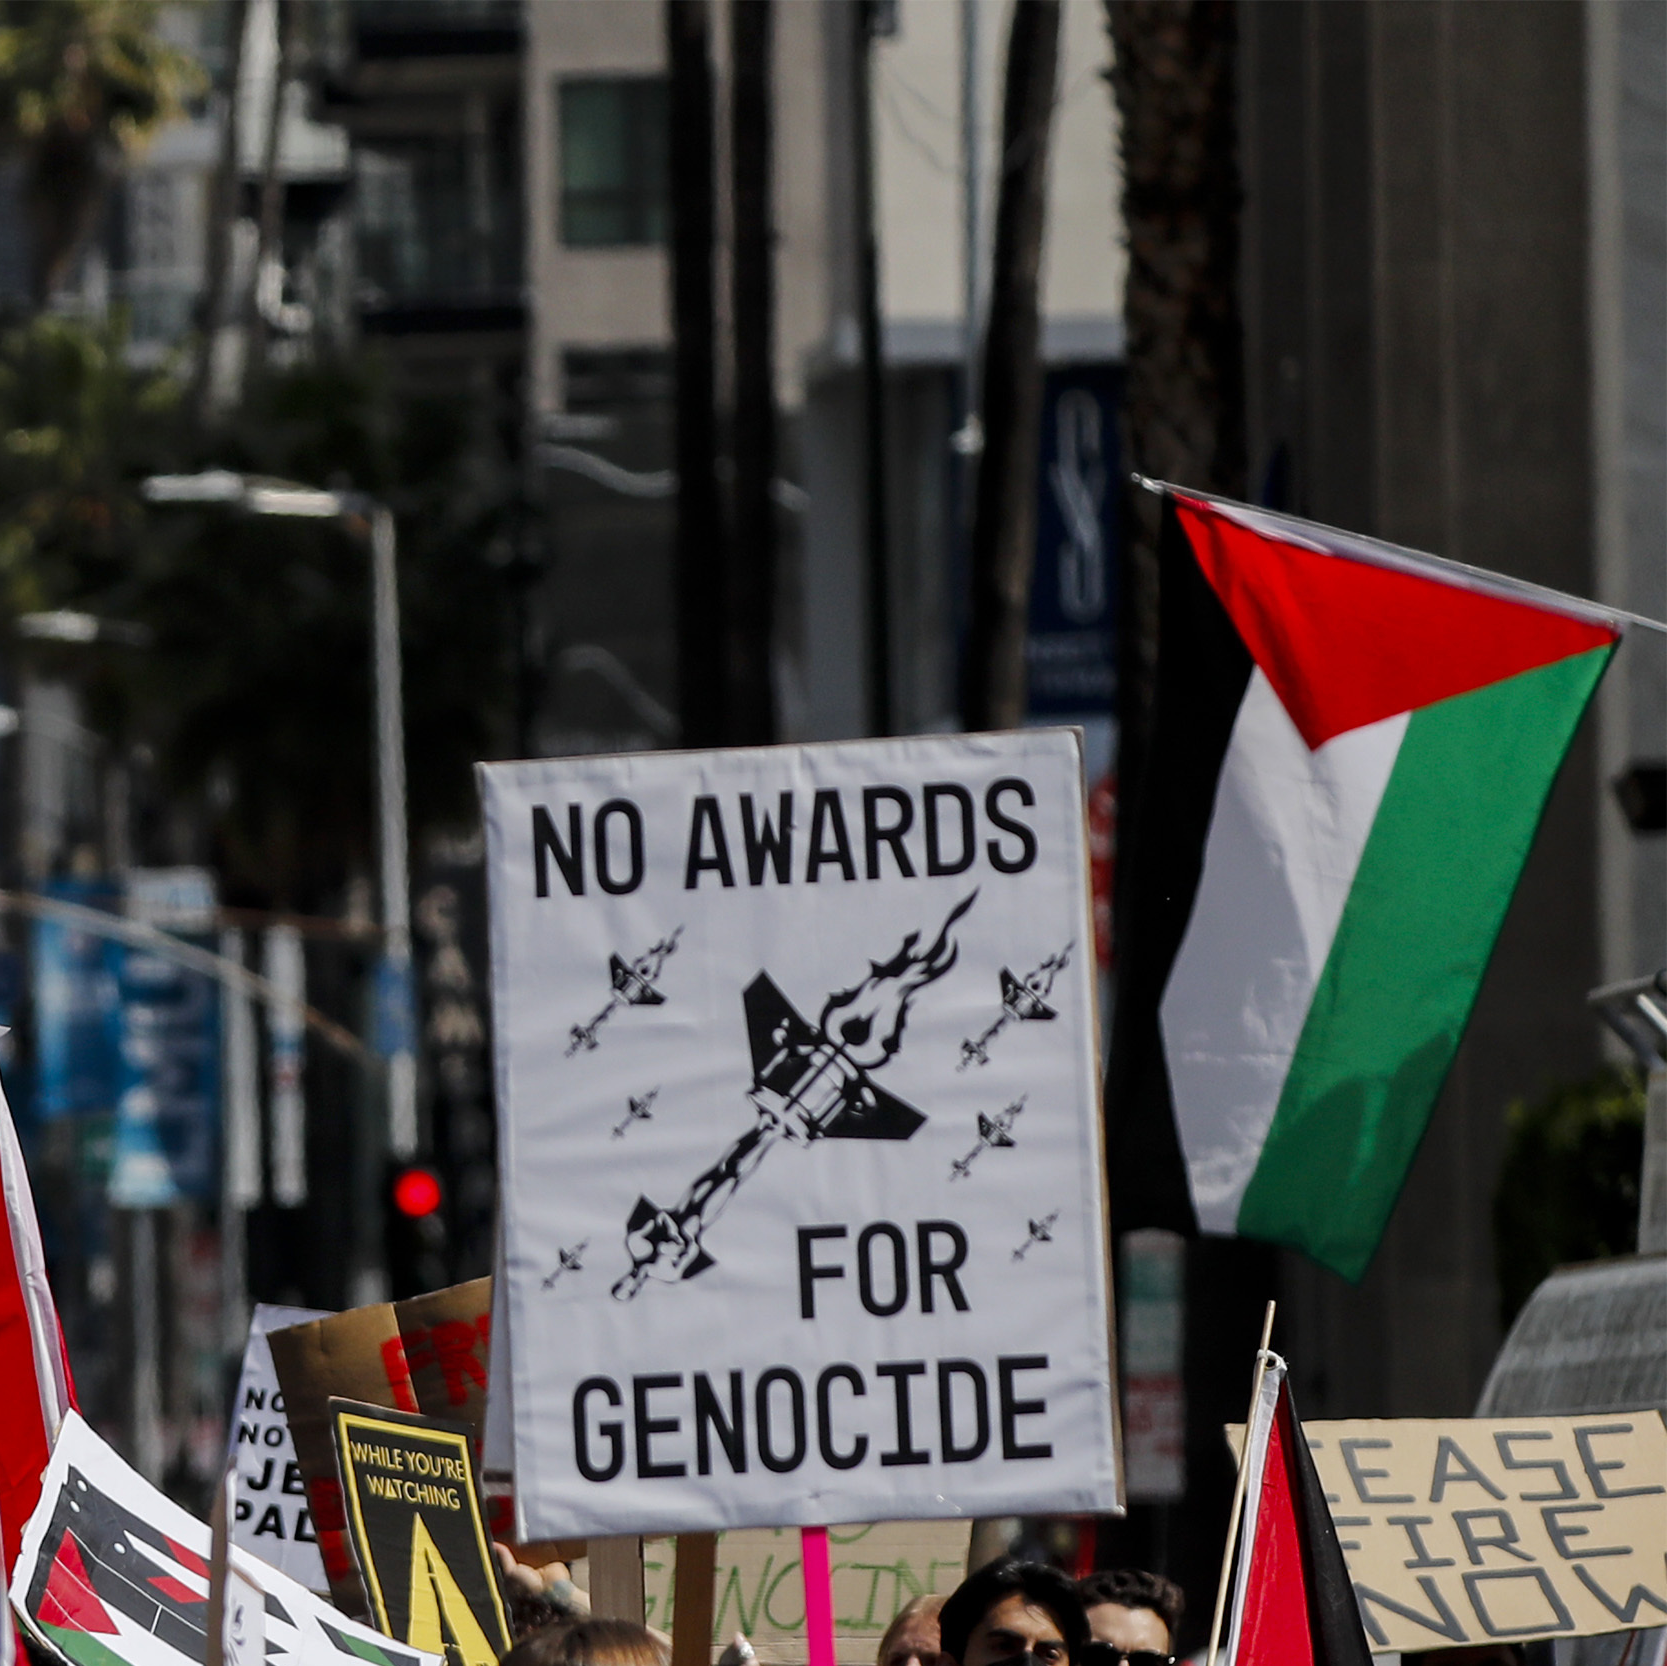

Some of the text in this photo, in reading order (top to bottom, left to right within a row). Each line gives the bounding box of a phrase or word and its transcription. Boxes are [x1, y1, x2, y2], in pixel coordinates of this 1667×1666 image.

[531, 798, 648, 899] NO
[685, 777, 1039, 891] AWARDS
[796, 1220, 971, 1321] FOR
[350, 1440, 467, 1482] WHILE YOU'RE
[572, 1354, 1054, 1484] GENOCIDE
[1306, 1422, 1667, 1504] EASE
[246, 1457, 304, 1496] JE
[366, 1473, 462, 1512] WATCHING
[1352, 1552, 1667, 1647] NOW
